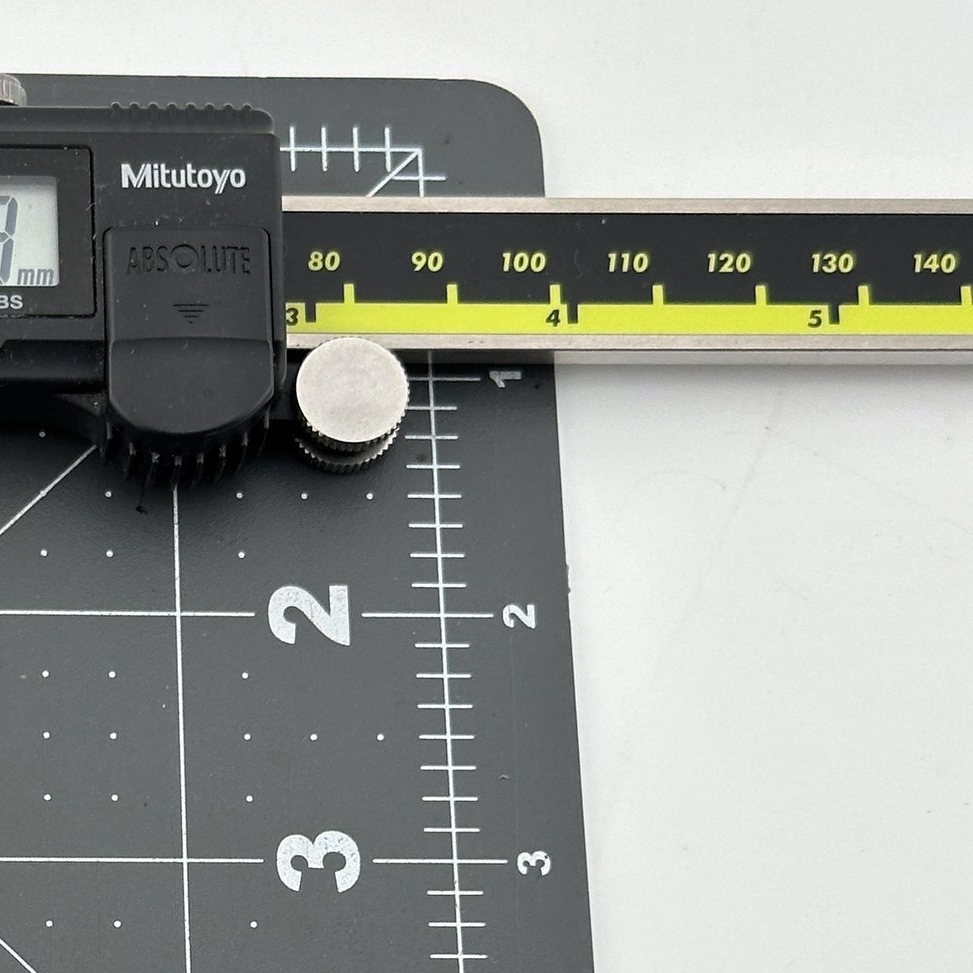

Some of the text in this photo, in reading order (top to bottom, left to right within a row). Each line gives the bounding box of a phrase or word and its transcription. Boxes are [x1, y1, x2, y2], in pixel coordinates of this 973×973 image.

[120, 163, 246, 195] Mitutoyo
[126, 243, 251, 275] ABSOLUTE
[308, 250, 341, 271] 80
[411, 251, 444, 272] 90
[502, 251, 546, 273] 100
[608, 252, 649, 273] 110
[707, 252, 752, 273] 120
[811, 253, 854, 273] 130
[913, 253, 957, 274] 140
[16, 268, 54, 286] mm
[286, 307, 299, 326] 3
[545, 308, 561, 328] 4
[807, 309, 823, 329] 5
[489, 370, 522, 388] 1
[268, 584, 351, 646] 2
[502, 603, 536, 629] 2
[276, 830, 361, 893] 3
[516, 850, 551, 876] 3
